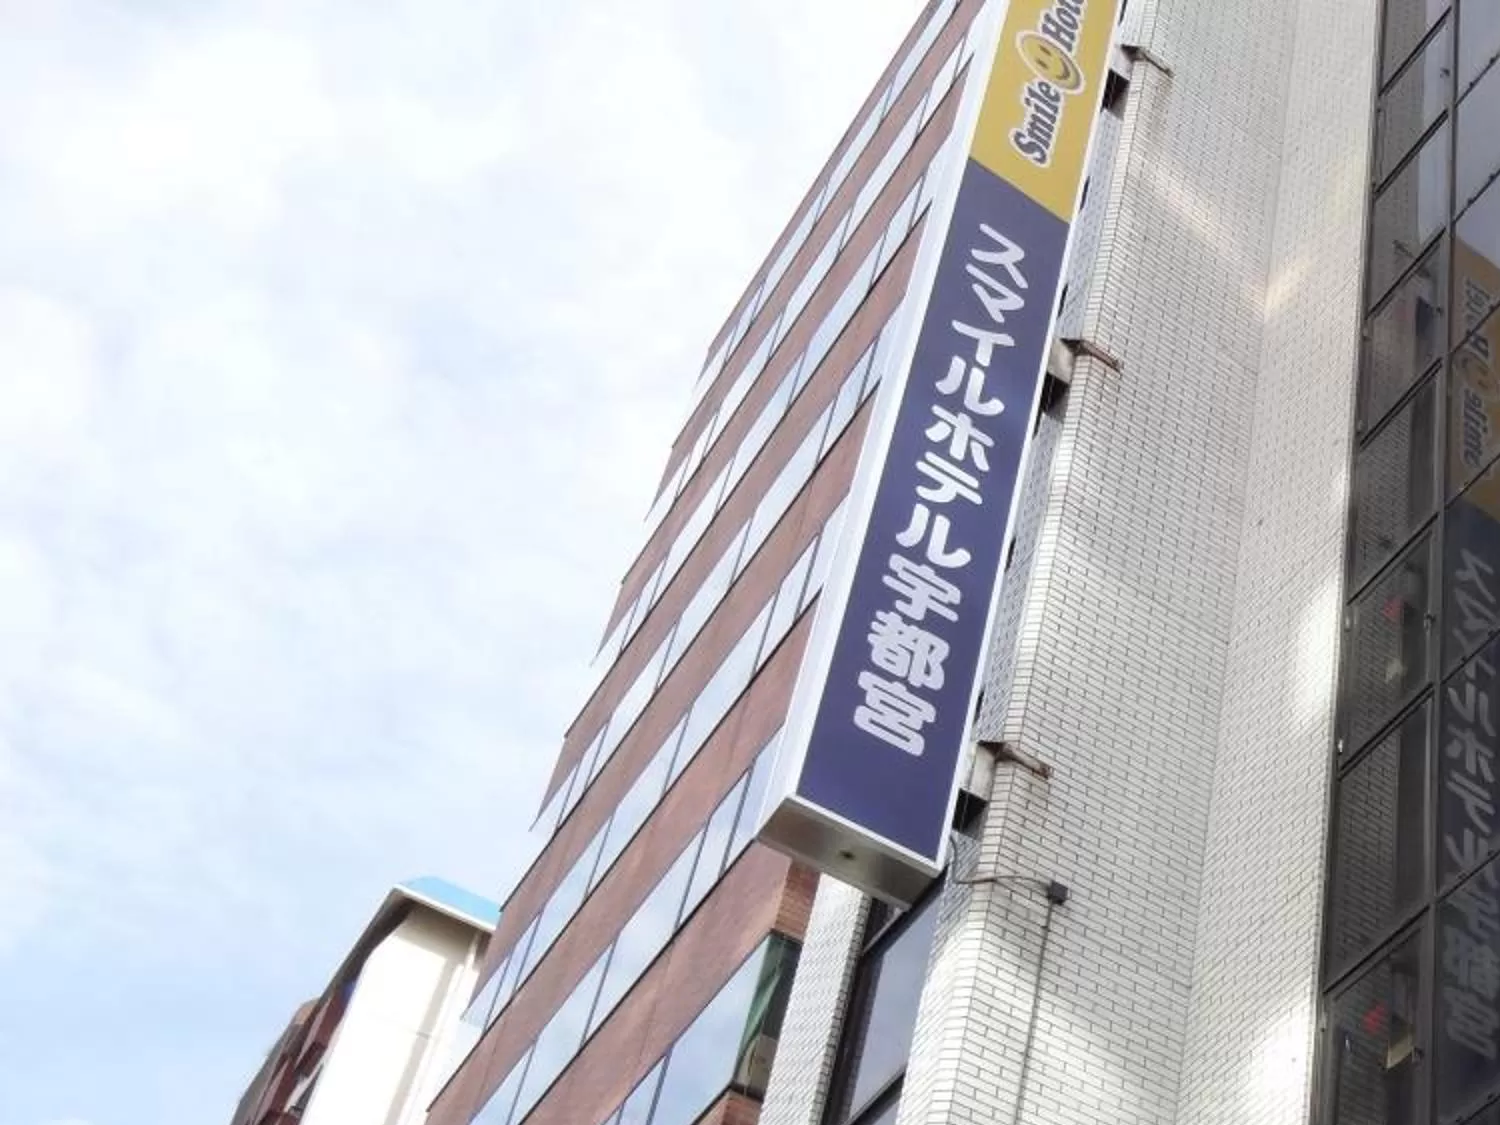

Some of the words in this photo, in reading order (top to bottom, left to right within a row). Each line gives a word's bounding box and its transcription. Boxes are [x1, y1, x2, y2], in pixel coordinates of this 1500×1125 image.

[1013, 80, 1060, 165] Smile
[853, 222, 1029, 757] スマイルホテル宇都宮
